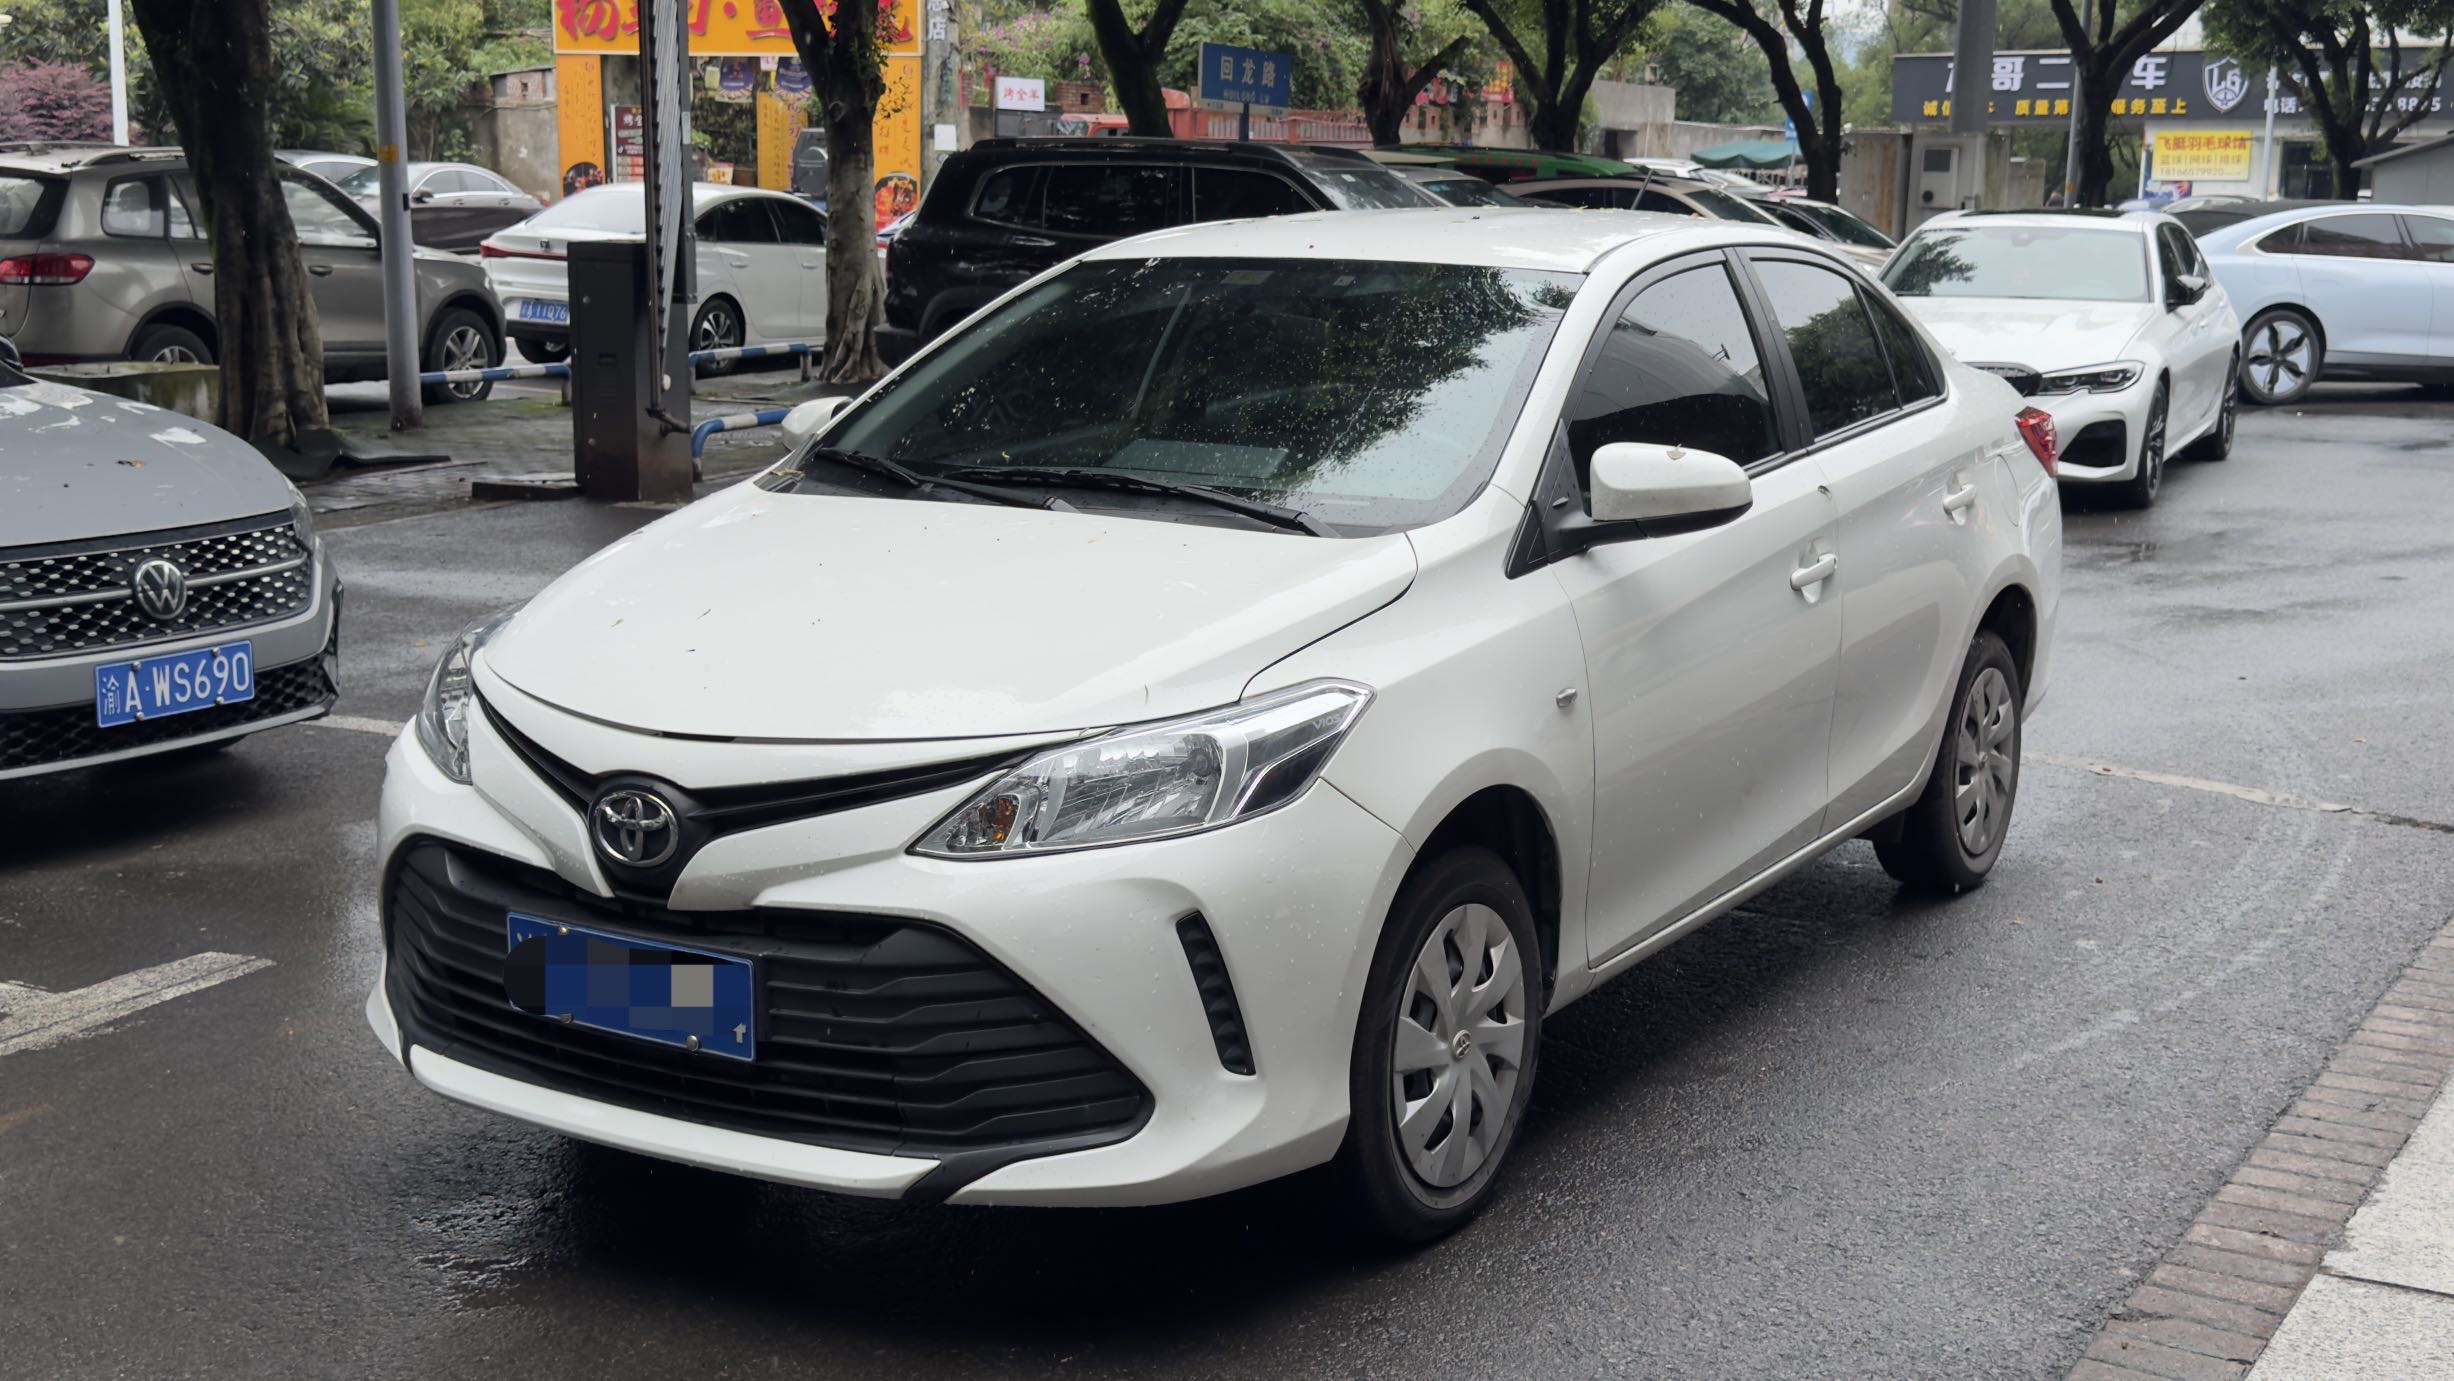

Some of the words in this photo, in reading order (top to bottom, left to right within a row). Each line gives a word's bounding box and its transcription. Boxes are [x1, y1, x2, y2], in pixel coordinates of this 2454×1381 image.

[1221, 56, 1276, 88] 回龙路
[1945, 56, 2168, 93] 哥二车
[1313, 714, 1341, 731] VIOS
